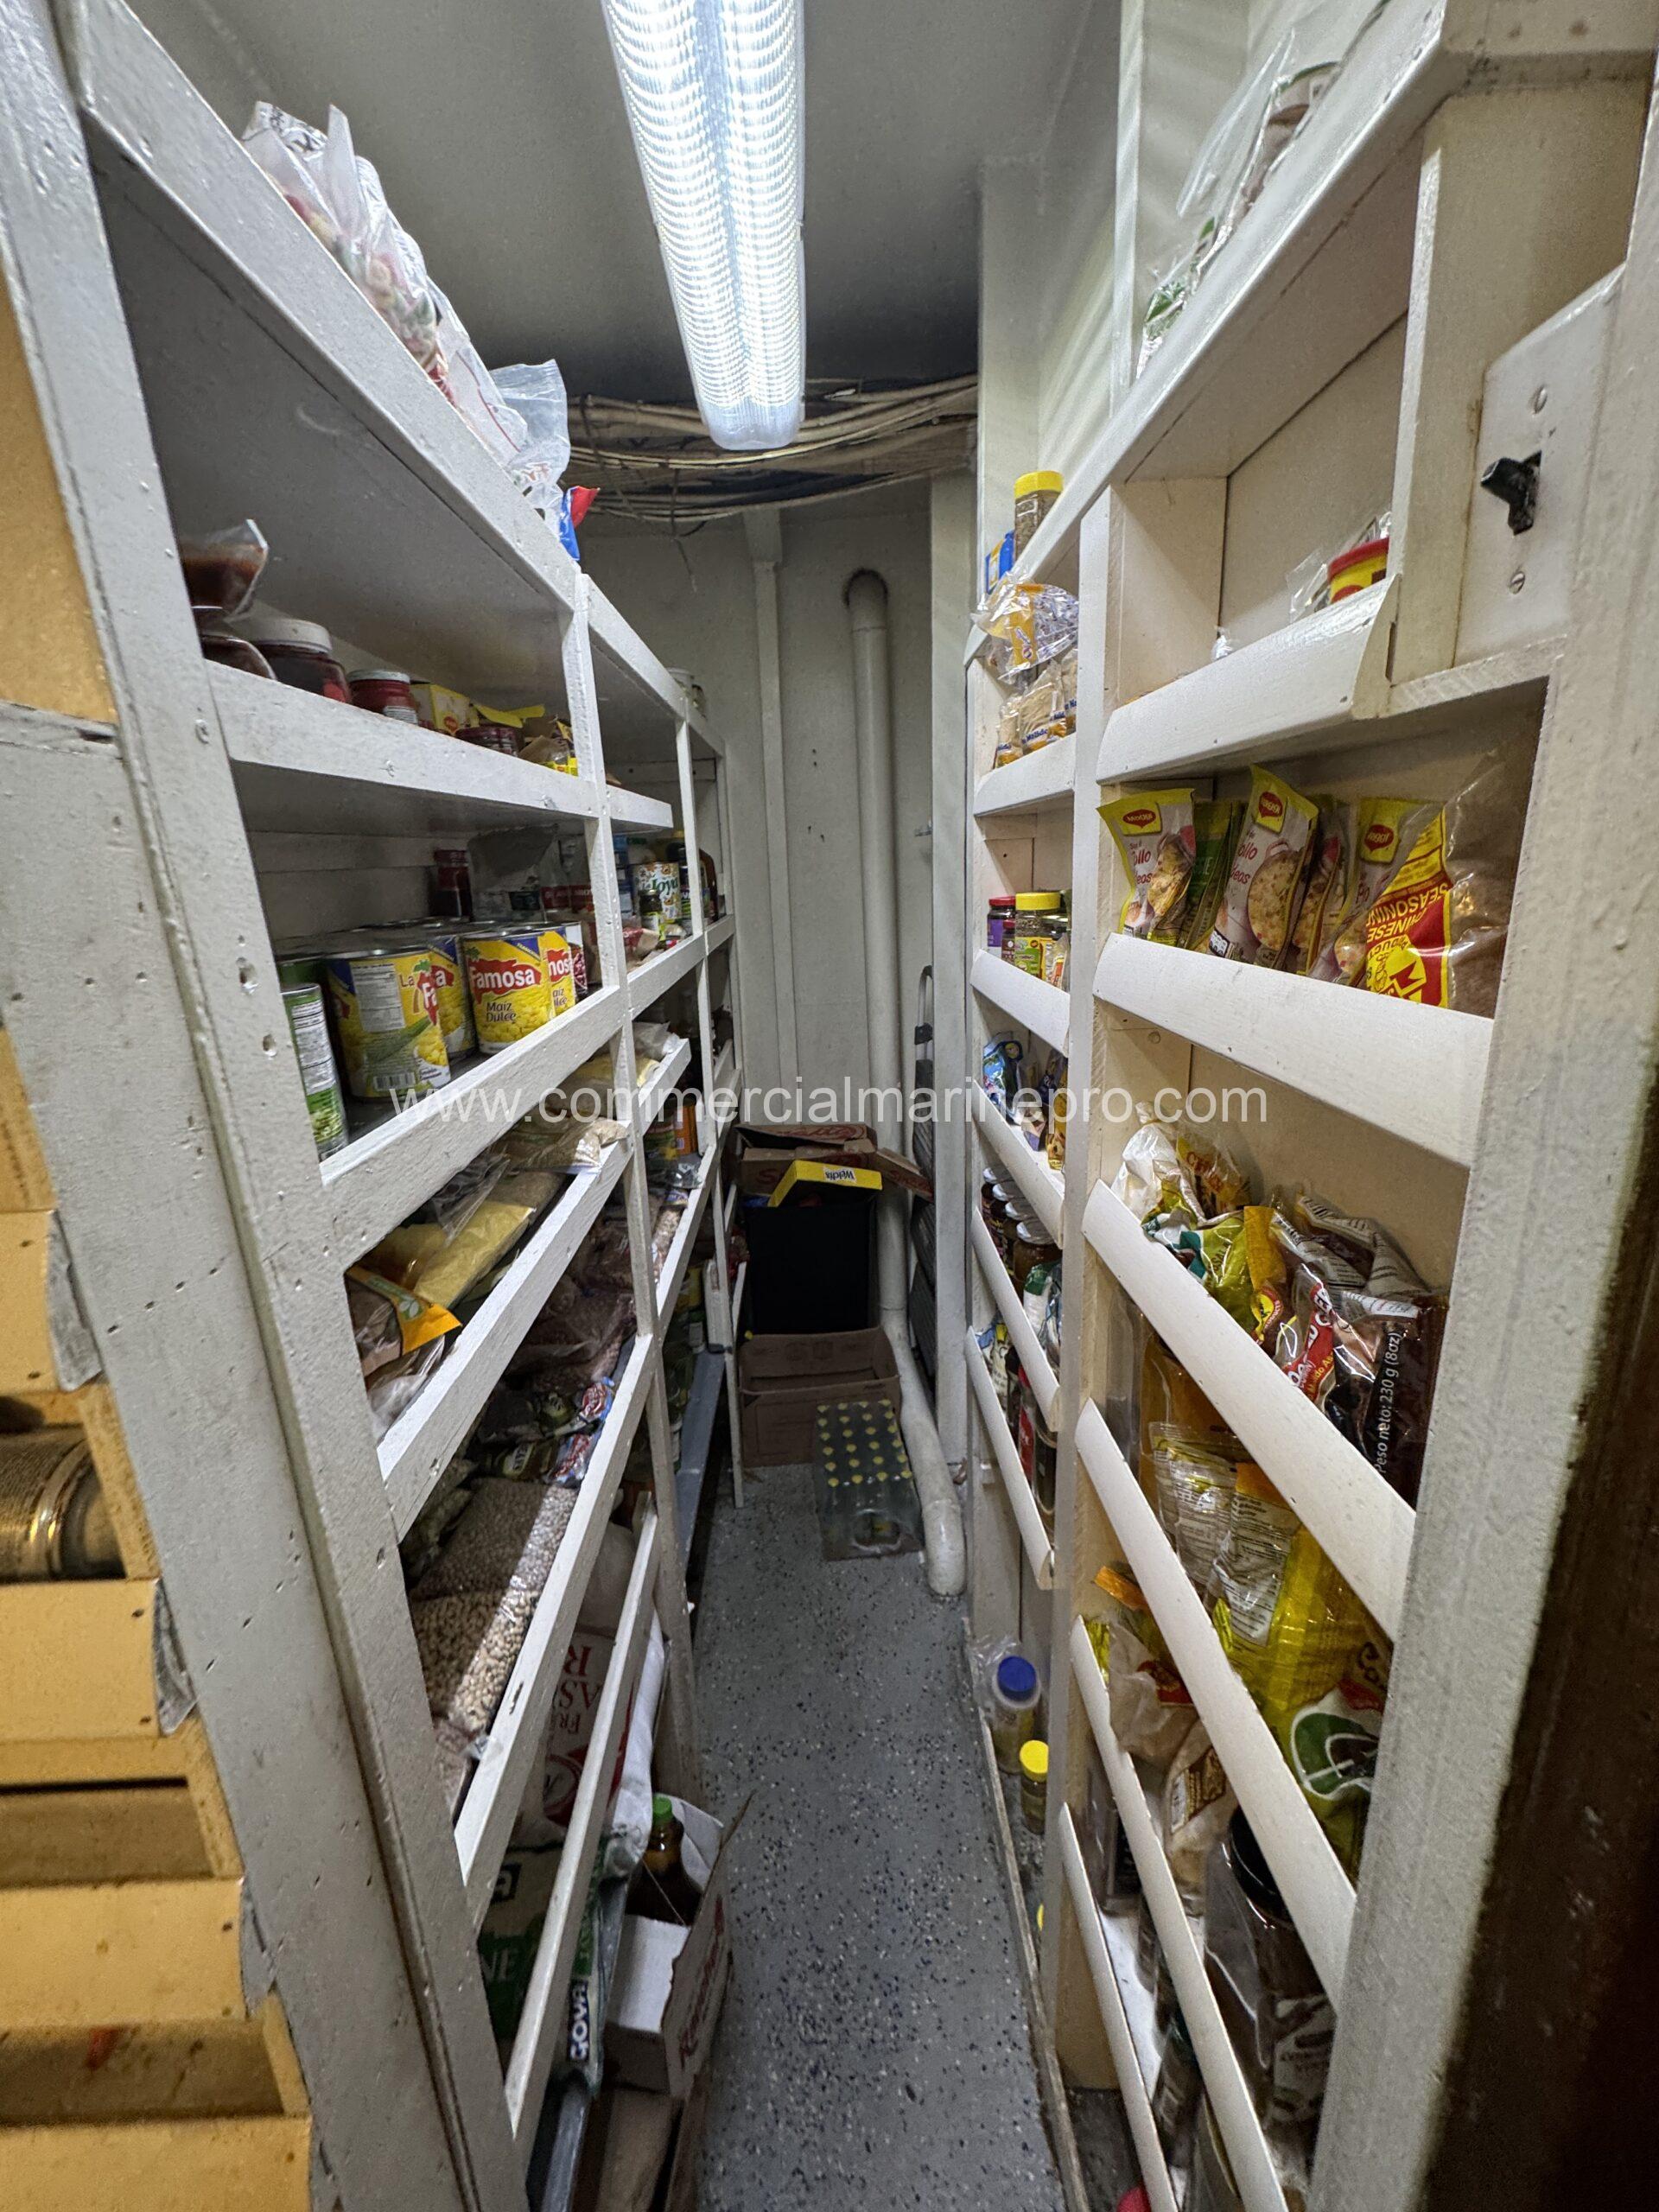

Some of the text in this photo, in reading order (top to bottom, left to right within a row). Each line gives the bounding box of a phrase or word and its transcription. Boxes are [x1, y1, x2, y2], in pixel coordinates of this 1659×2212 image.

[469, 966, 536, 989] Famosa
[486, 1012, 517, 1024] Dulce
[1385, 1368, 1400, 1378] g
[1379, 1379, 1395, 1404] 230
[1378, 1405, 1392, 1440] neto:
[1374, 1442, 1389, 1474] Peso
